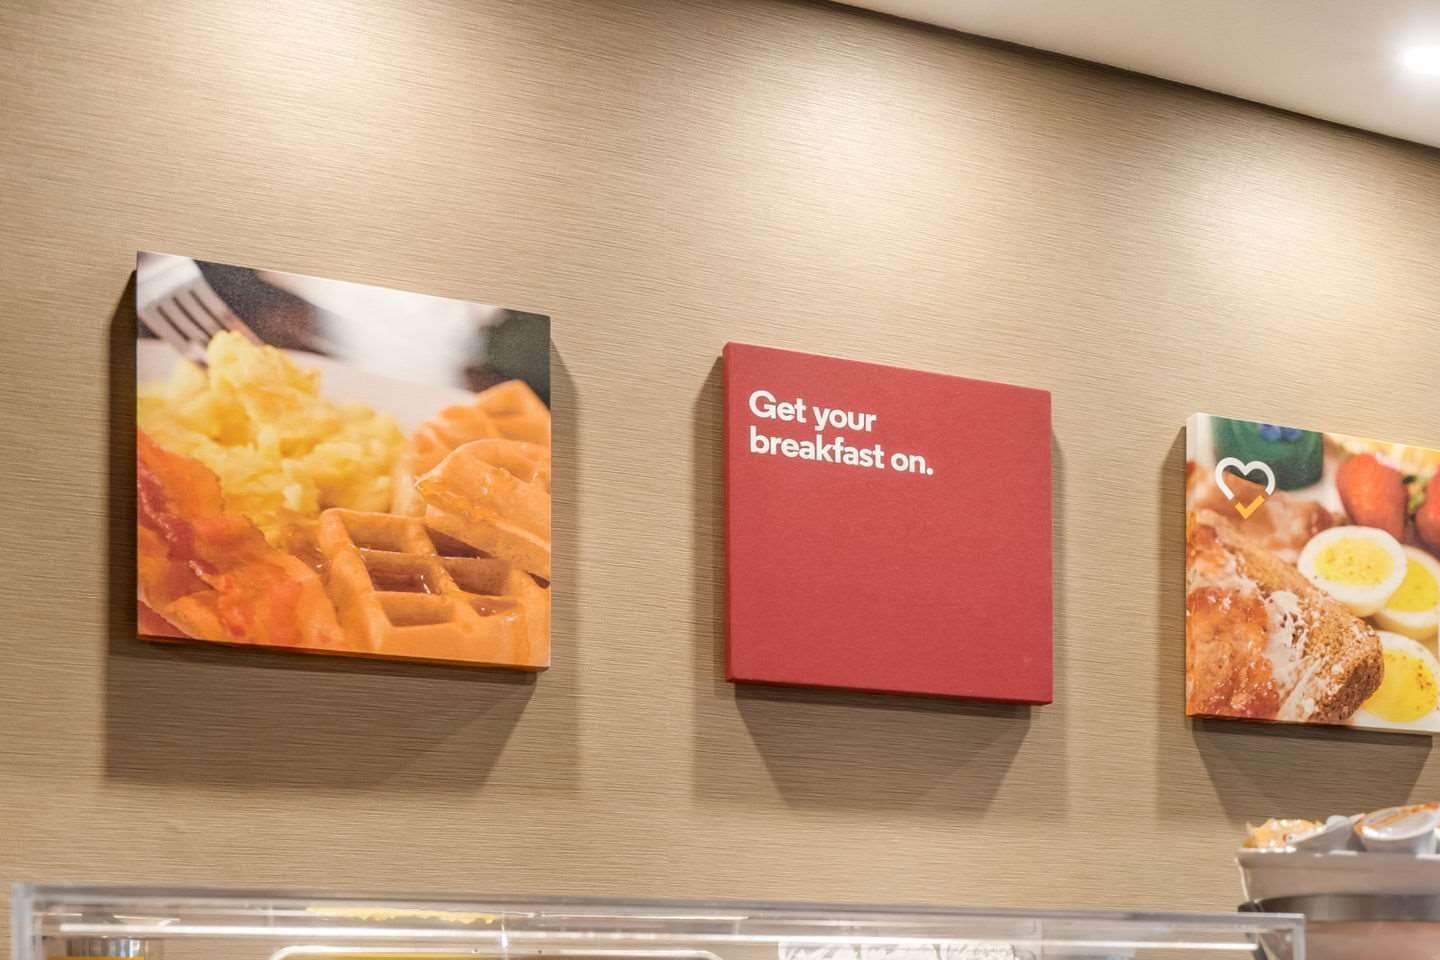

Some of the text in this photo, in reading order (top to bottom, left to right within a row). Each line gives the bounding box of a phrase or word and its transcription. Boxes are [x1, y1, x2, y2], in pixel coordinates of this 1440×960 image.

[748, 389, 877, 432] Get your
[749, 425, 935, 476] breakfast on.
